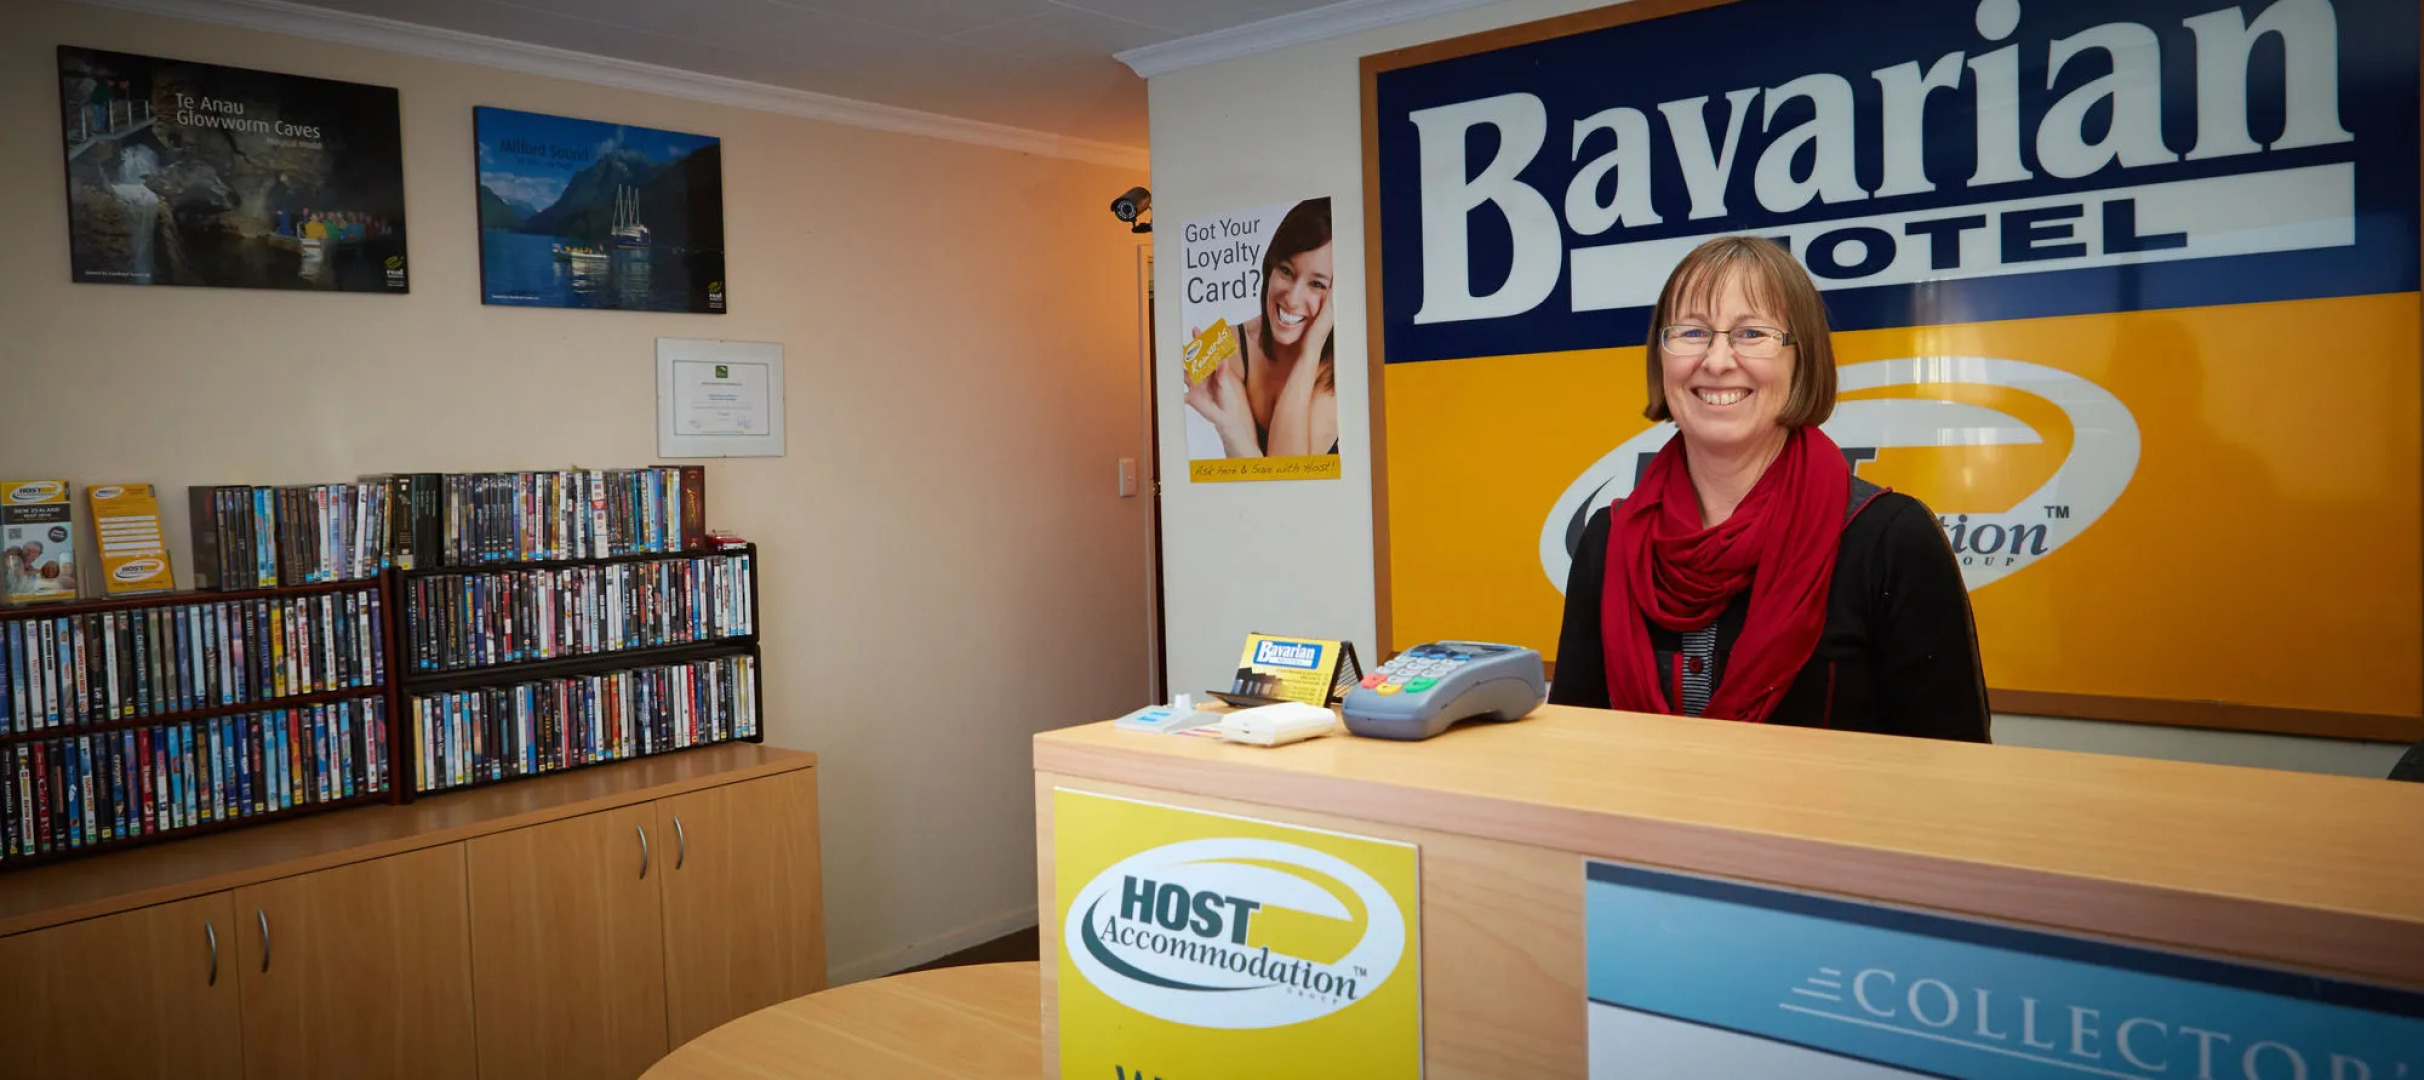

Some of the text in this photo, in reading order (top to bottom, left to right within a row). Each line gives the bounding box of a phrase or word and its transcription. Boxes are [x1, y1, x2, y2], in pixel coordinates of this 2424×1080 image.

[175, 92, 244, 115] Te Anau
[176, 109, 321, 139] Glowworm Caves
[500, 139, 589, 161] Milford Sound
[1410, 0, 2355, 325] Bavarian
[1185, 217, 1261, 243] Got Your
[1768, 197, 2188, 280] OTEL
[1186, 240, 1261, 271] Loyalty
[1187, 270, 1261, 304] Card?
[1195, 464, 1213, 476] Ask
[1217, 465, 1237, 476] here
[1252, 463, 1273, 474] Save
[1275, 461, 1299, 473] with
[2044, 505, 2070, 519] TM
[1962, 556, 2015, 567] OUP
[1256, 640, 1316, 662] Bavarian
[1119, 875, 1260, 946] HOST
[1099, 914, 1358, 1002] Accommodation
[1352, 965, 1367, 977] TM
